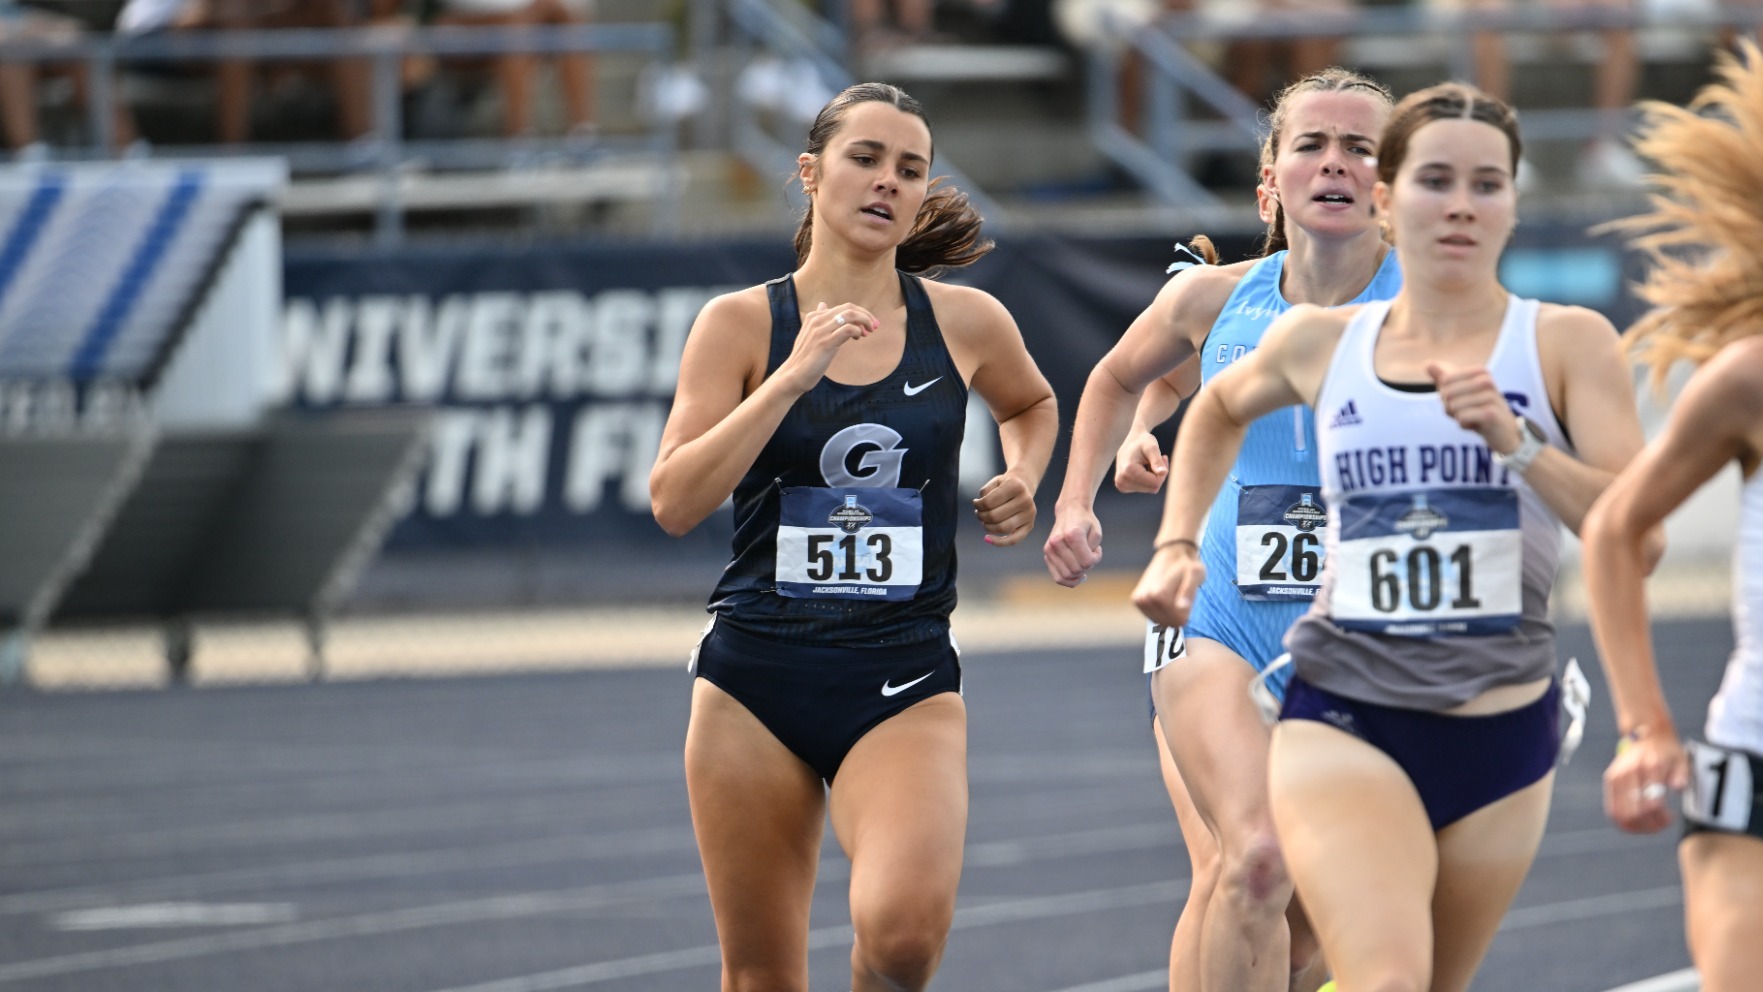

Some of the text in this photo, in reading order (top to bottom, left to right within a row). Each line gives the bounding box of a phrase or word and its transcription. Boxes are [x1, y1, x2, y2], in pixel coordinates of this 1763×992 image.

[819, 423, 909, 488] G
[1336, 447, 1409, 491] HIGH
[807, 533, 892, 582] 513
[1259, 532, 1325, 582] 26
[1370, 543, 1481, 613] 601
[812, 586, 887, 596] JACKSONVILLE, FLORIDA
[1267, 587, 1315, 595] JACKSONVILLE,
